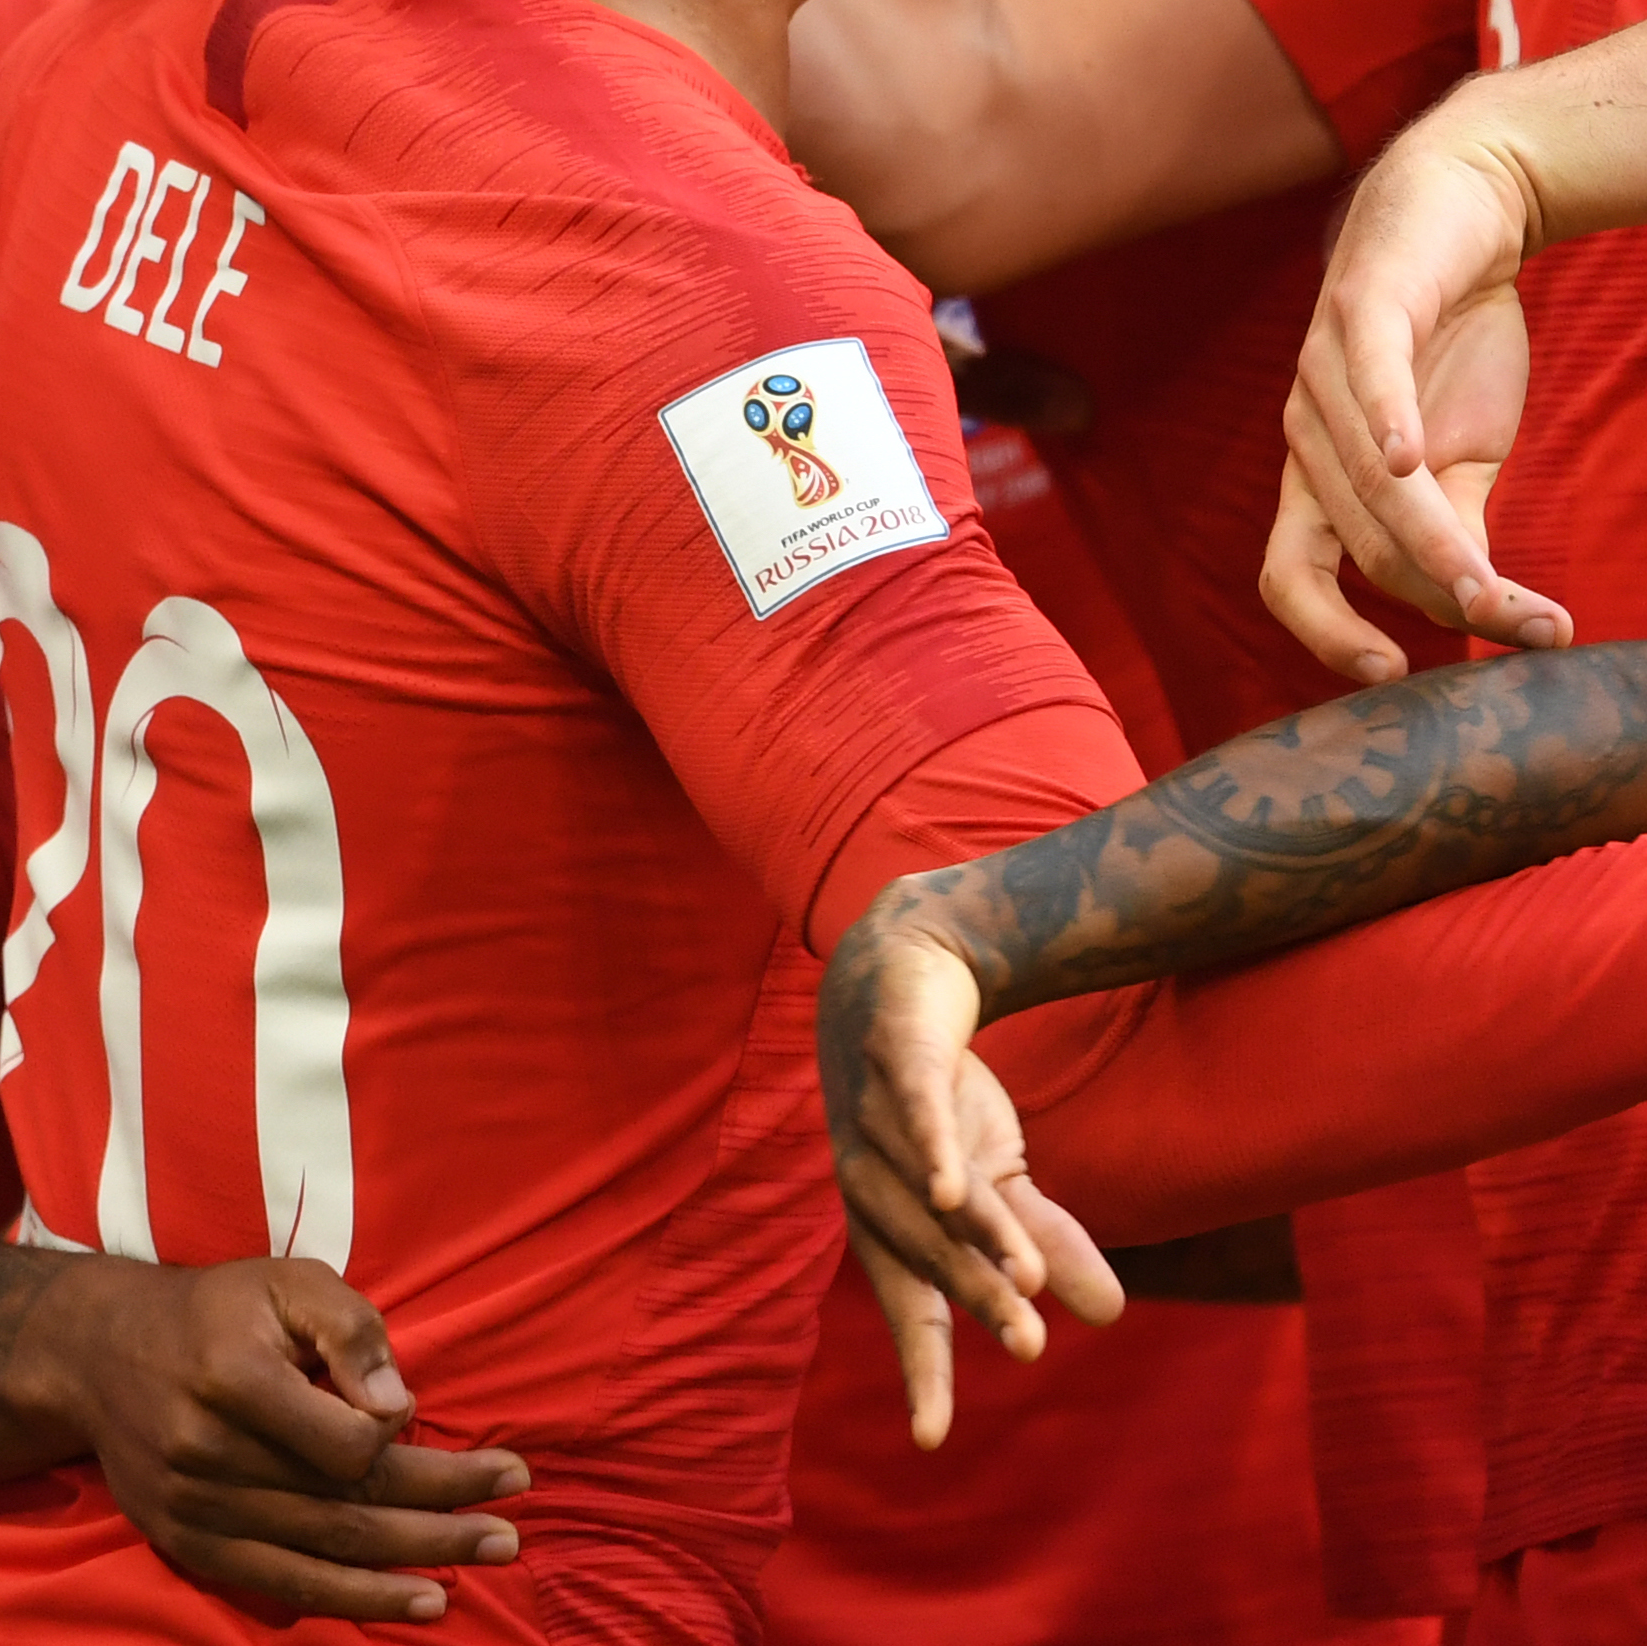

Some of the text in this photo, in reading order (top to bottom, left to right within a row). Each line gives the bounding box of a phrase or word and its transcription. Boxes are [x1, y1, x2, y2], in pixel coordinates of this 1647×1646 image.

[59, 140, 266, 368] DELE
[754, 505, 927, 593] RUSSIA 2018
[780, 497, 880, 549] FIFA WORLD CUP
